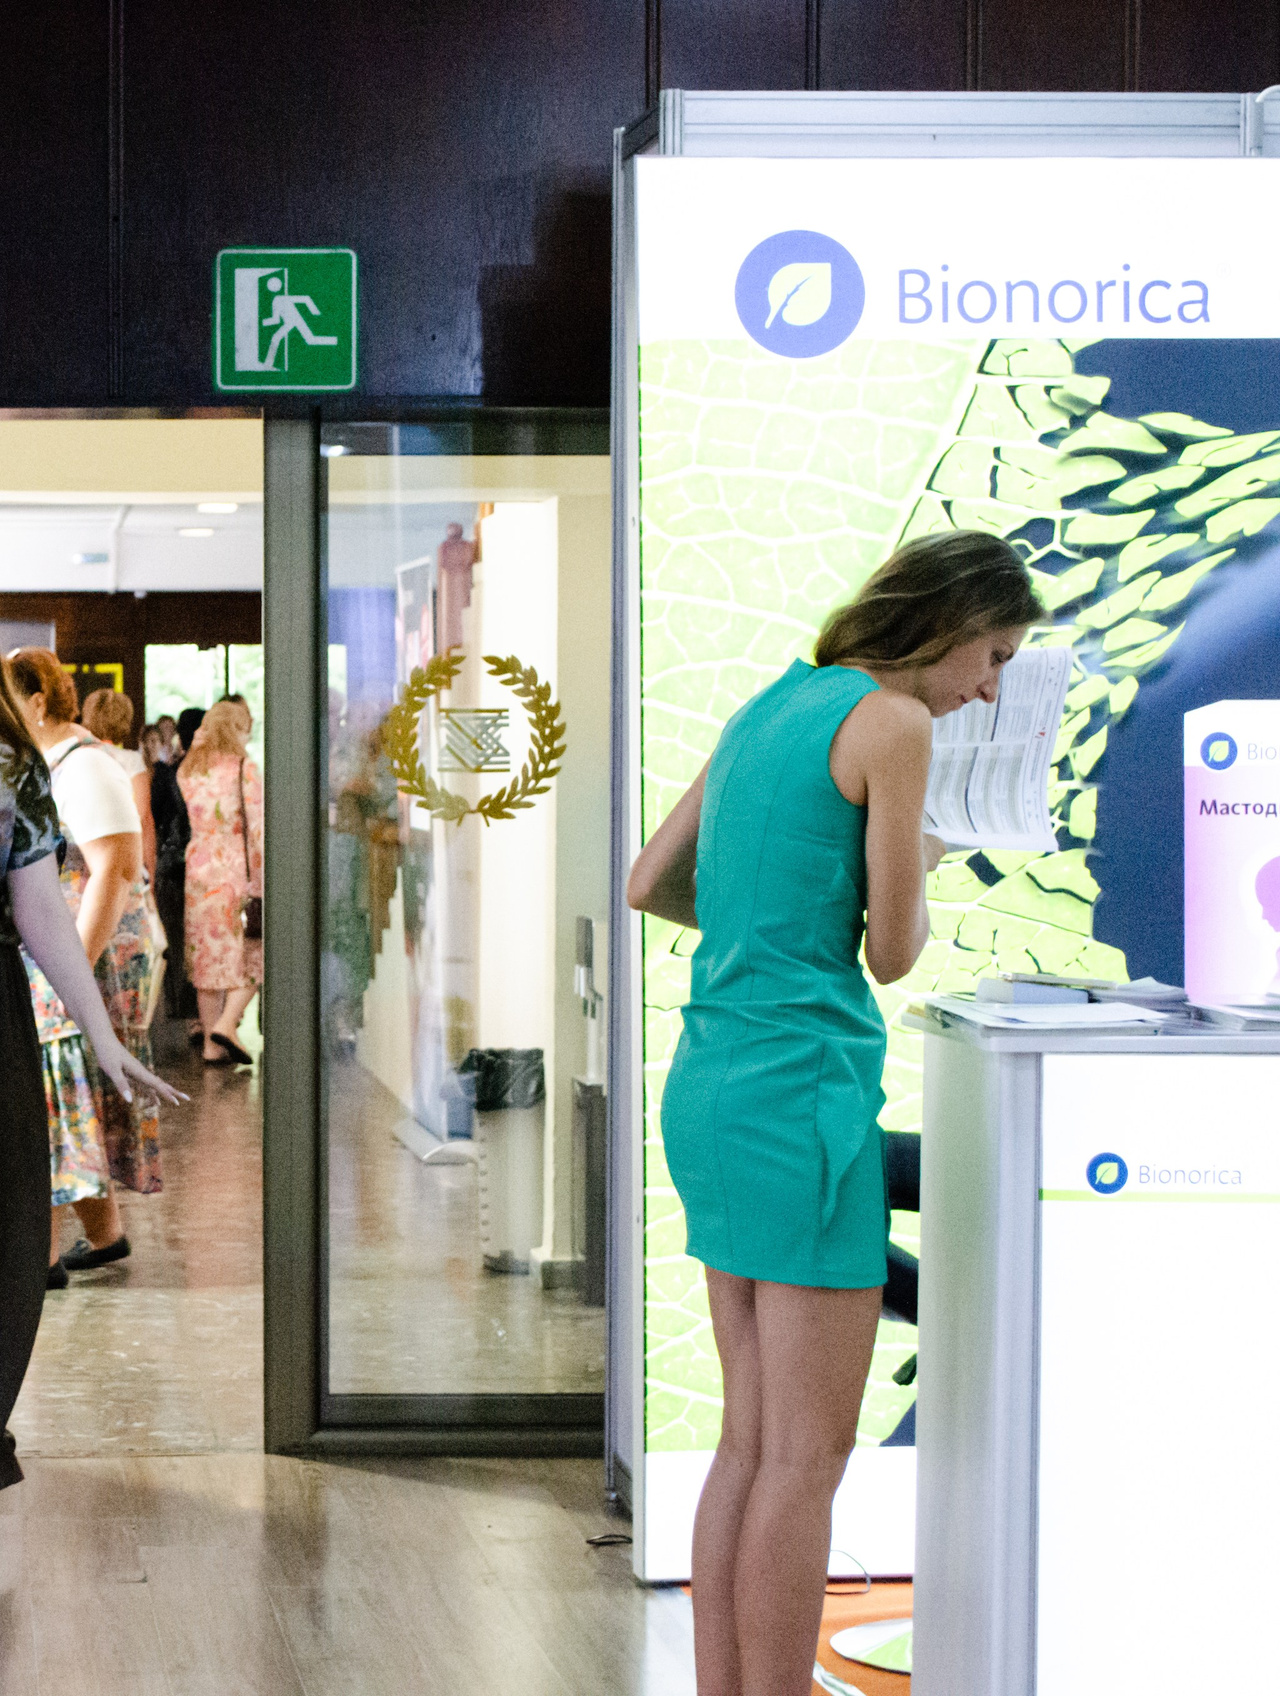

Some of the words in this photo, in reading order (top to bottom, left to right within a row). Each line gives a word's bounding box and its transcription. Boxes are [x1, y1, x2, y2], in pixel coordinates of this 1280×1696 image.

[897, 263, 1211, 325] Bionorica
[1247, 741, 1280, 761] Bio
[1199, 799, 1280, 818] Мастод
[1138, 1163, 1243, 1186] Bionorica
